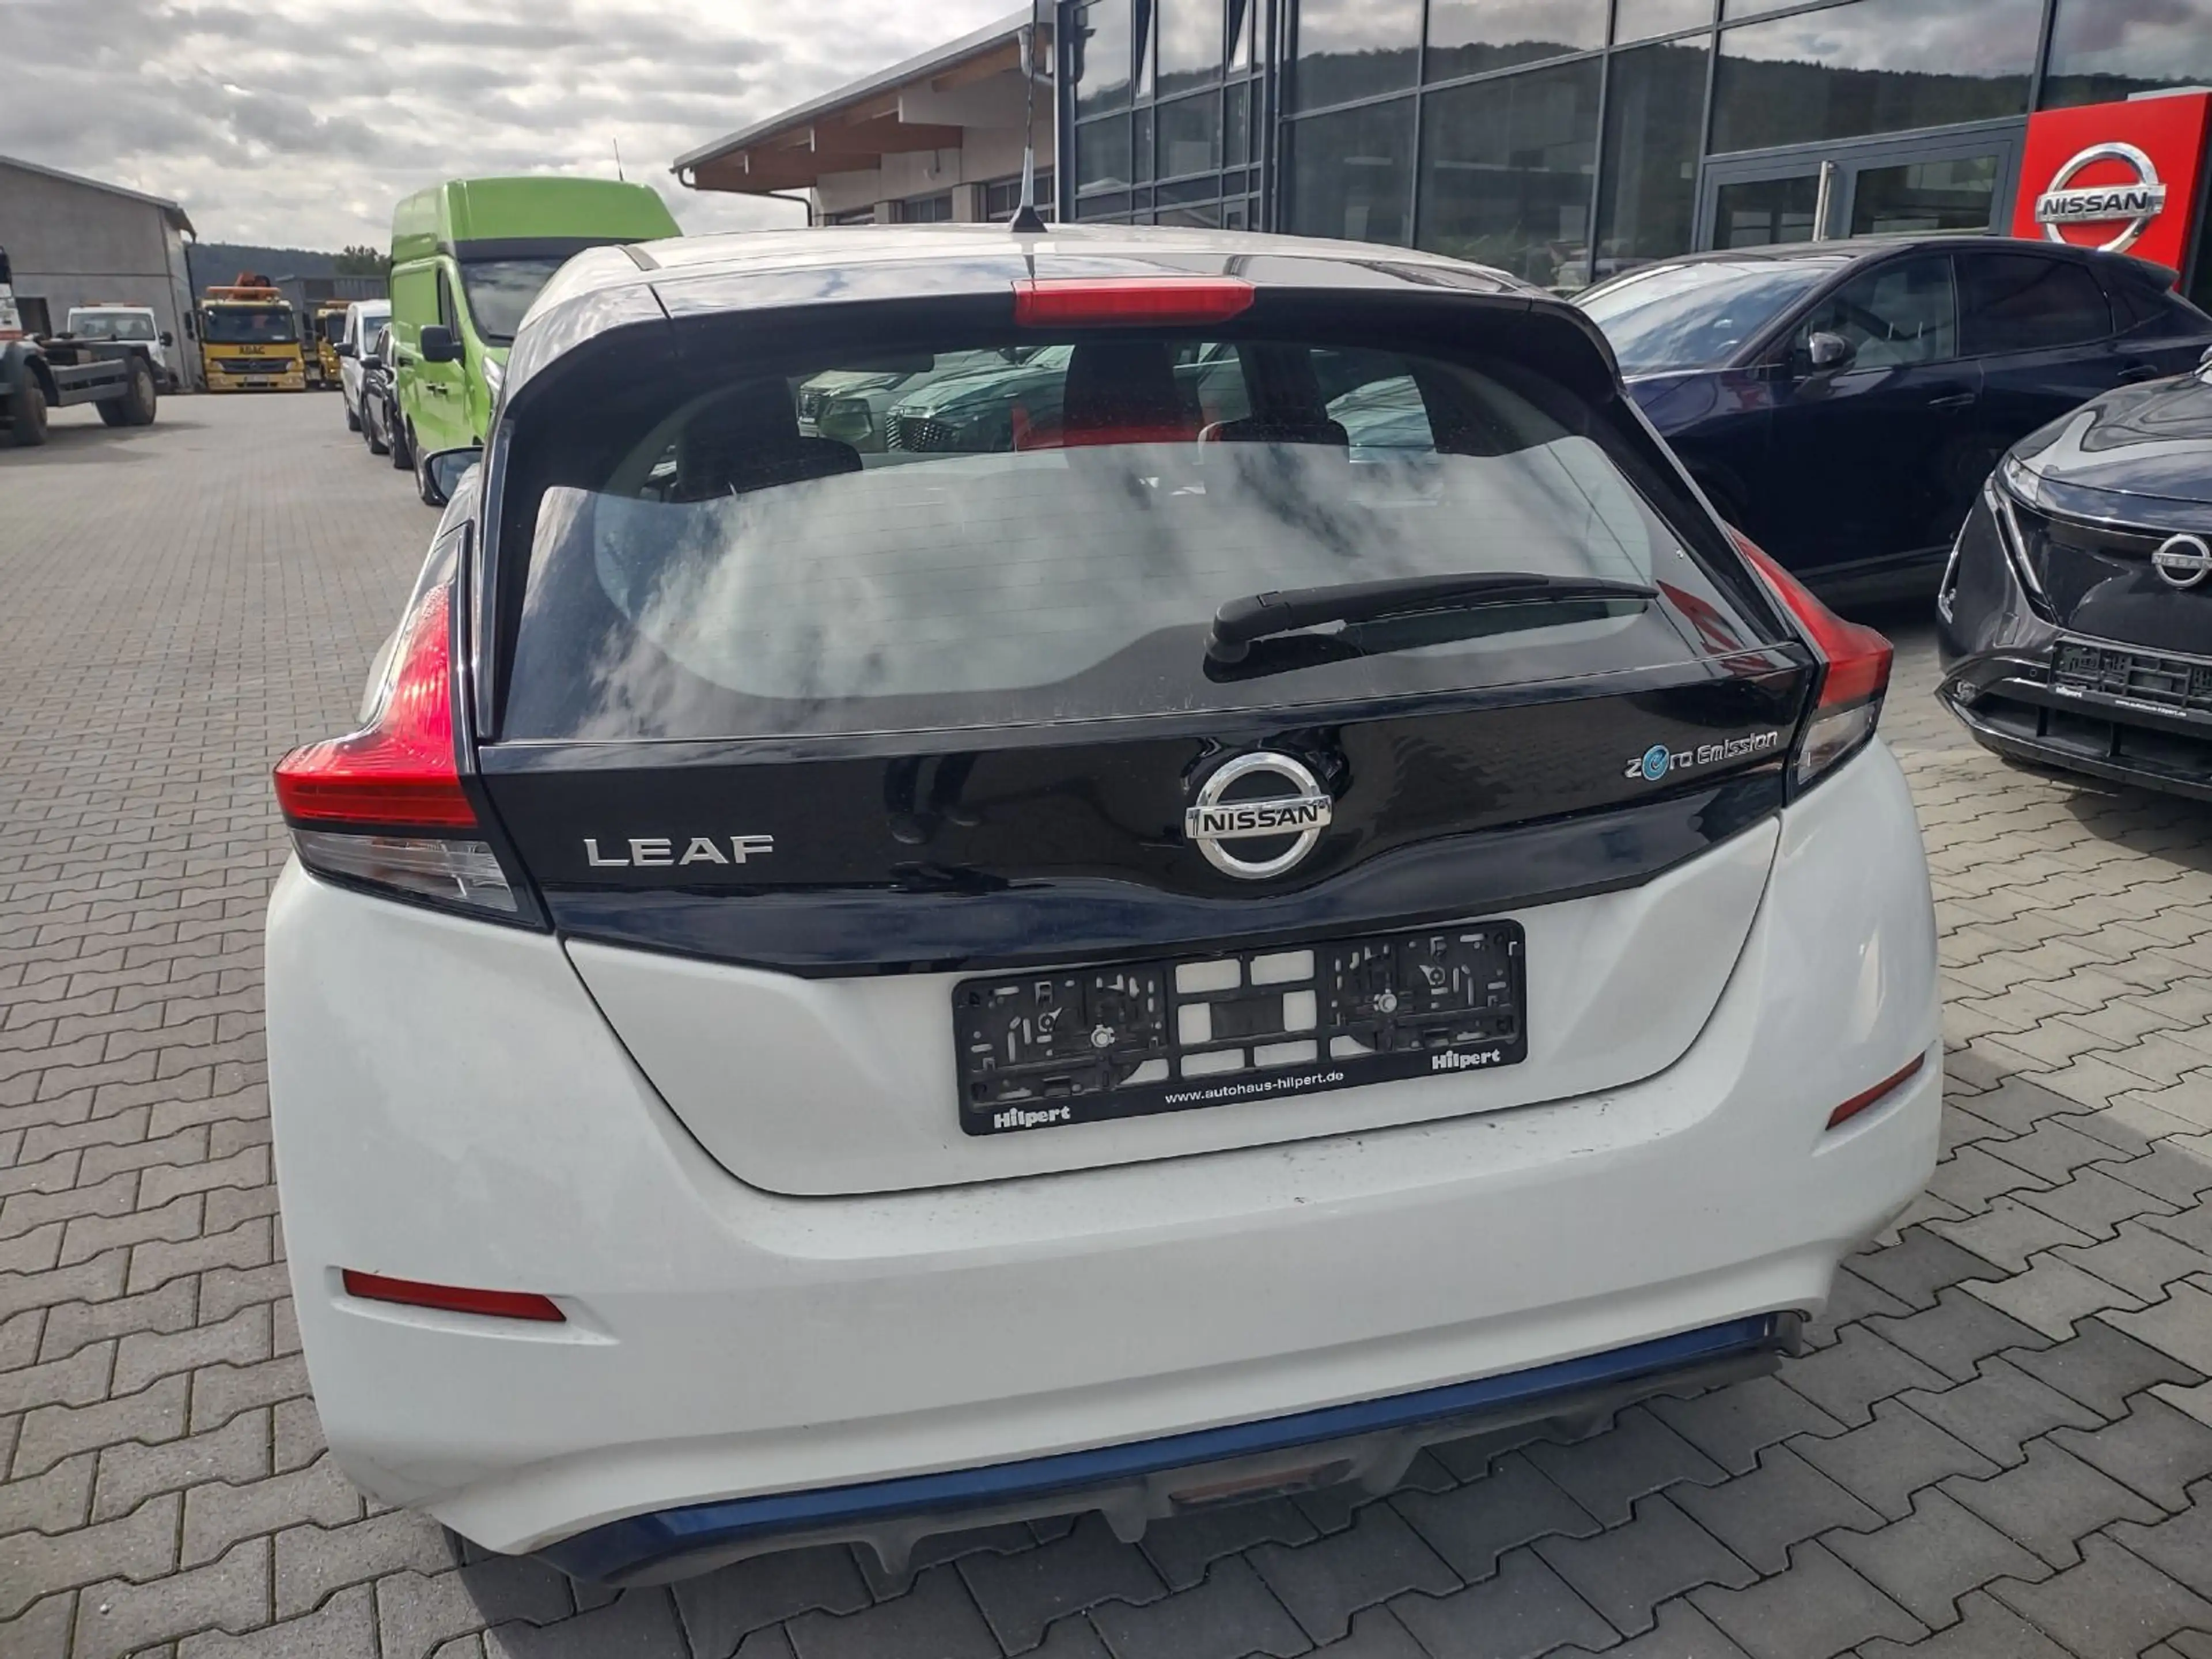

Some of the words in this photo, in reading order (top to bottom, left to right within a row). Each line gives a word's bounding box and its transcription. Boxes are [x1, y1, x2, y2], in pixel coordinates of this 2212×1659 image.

[2043, 192, 2148, 216] NISSAN
[1696, 730, 1778, 764] Emission
[1203, 805, 1319, 832] NISSAN
[583, 834, 774, 866] LEAF
[1431, 1048, 1501, 1070] Hilpert
[1165, 1070, 1344, 1104] www.autohaus-hilpert.de
[994, 1105, 1071, 1128] Hilpert
